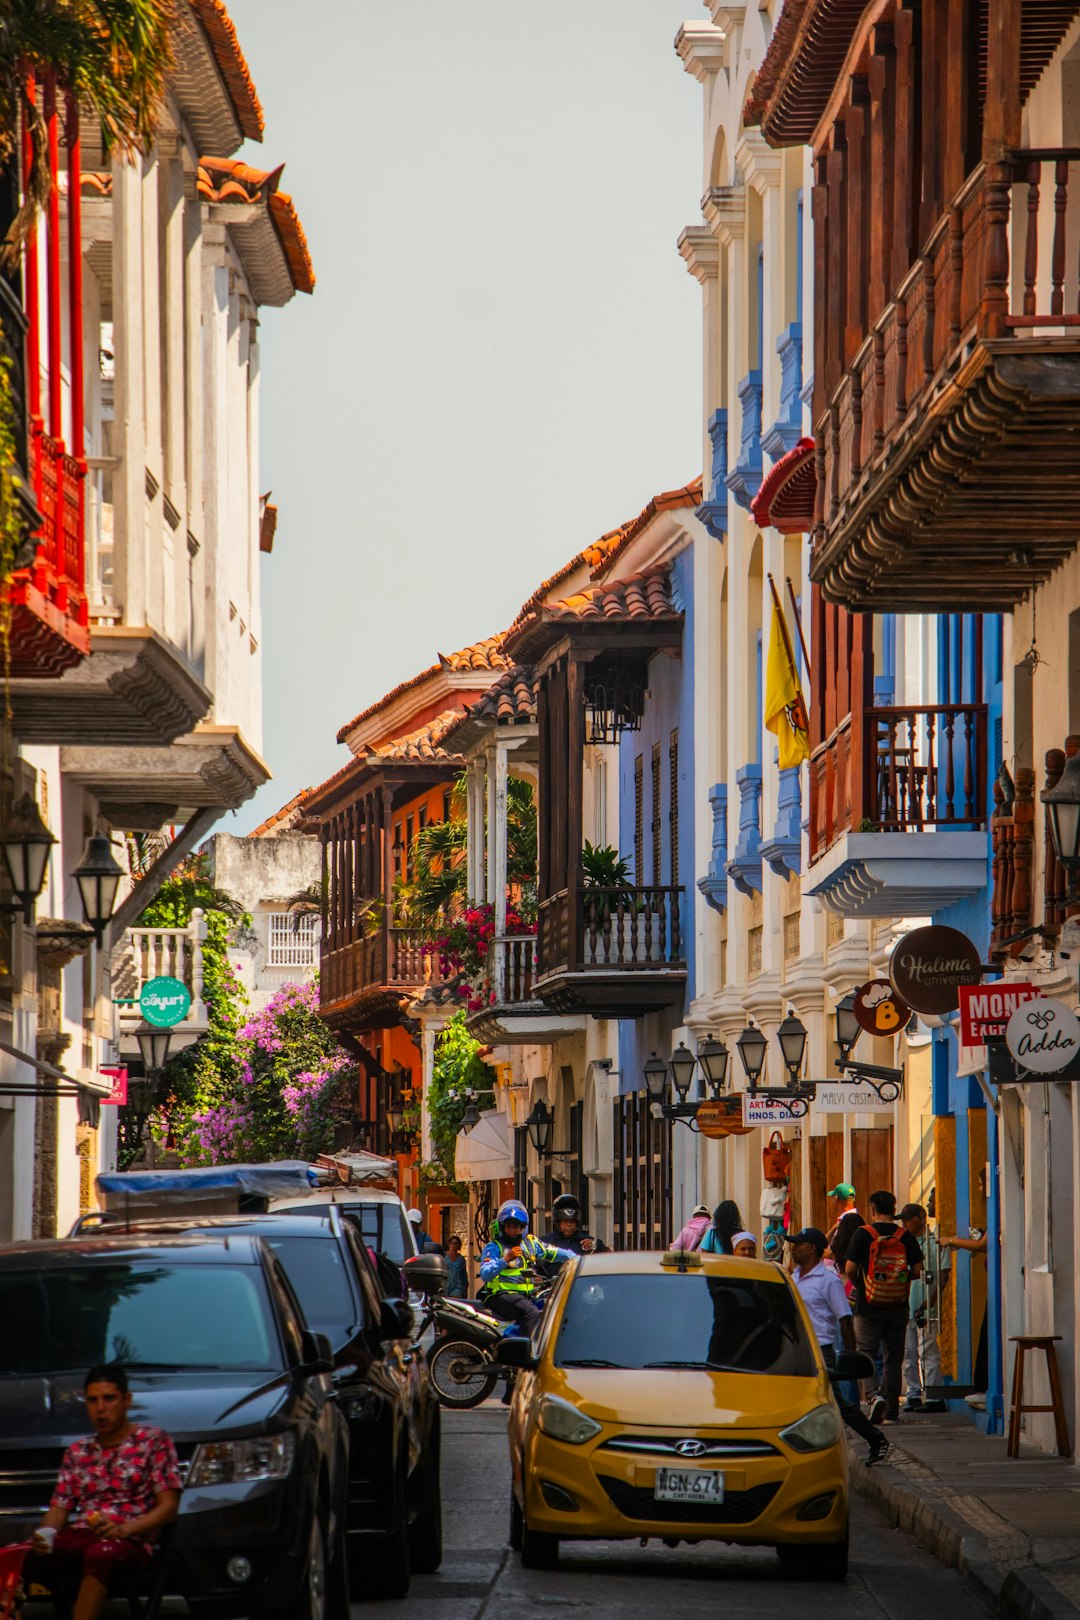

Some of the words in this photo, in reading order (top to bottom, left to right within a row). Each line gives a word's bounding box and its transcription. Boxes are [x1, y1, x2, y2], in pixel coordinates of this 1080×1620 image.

[900, 953, 971, 982] Halima
[924, 974, 975, 986] universo
[749, 1100, 799, 1109] ARTANIS
[821, 1093, 845, 1105] MALVI
[748, 1111, 777, 1120] HNOS.
